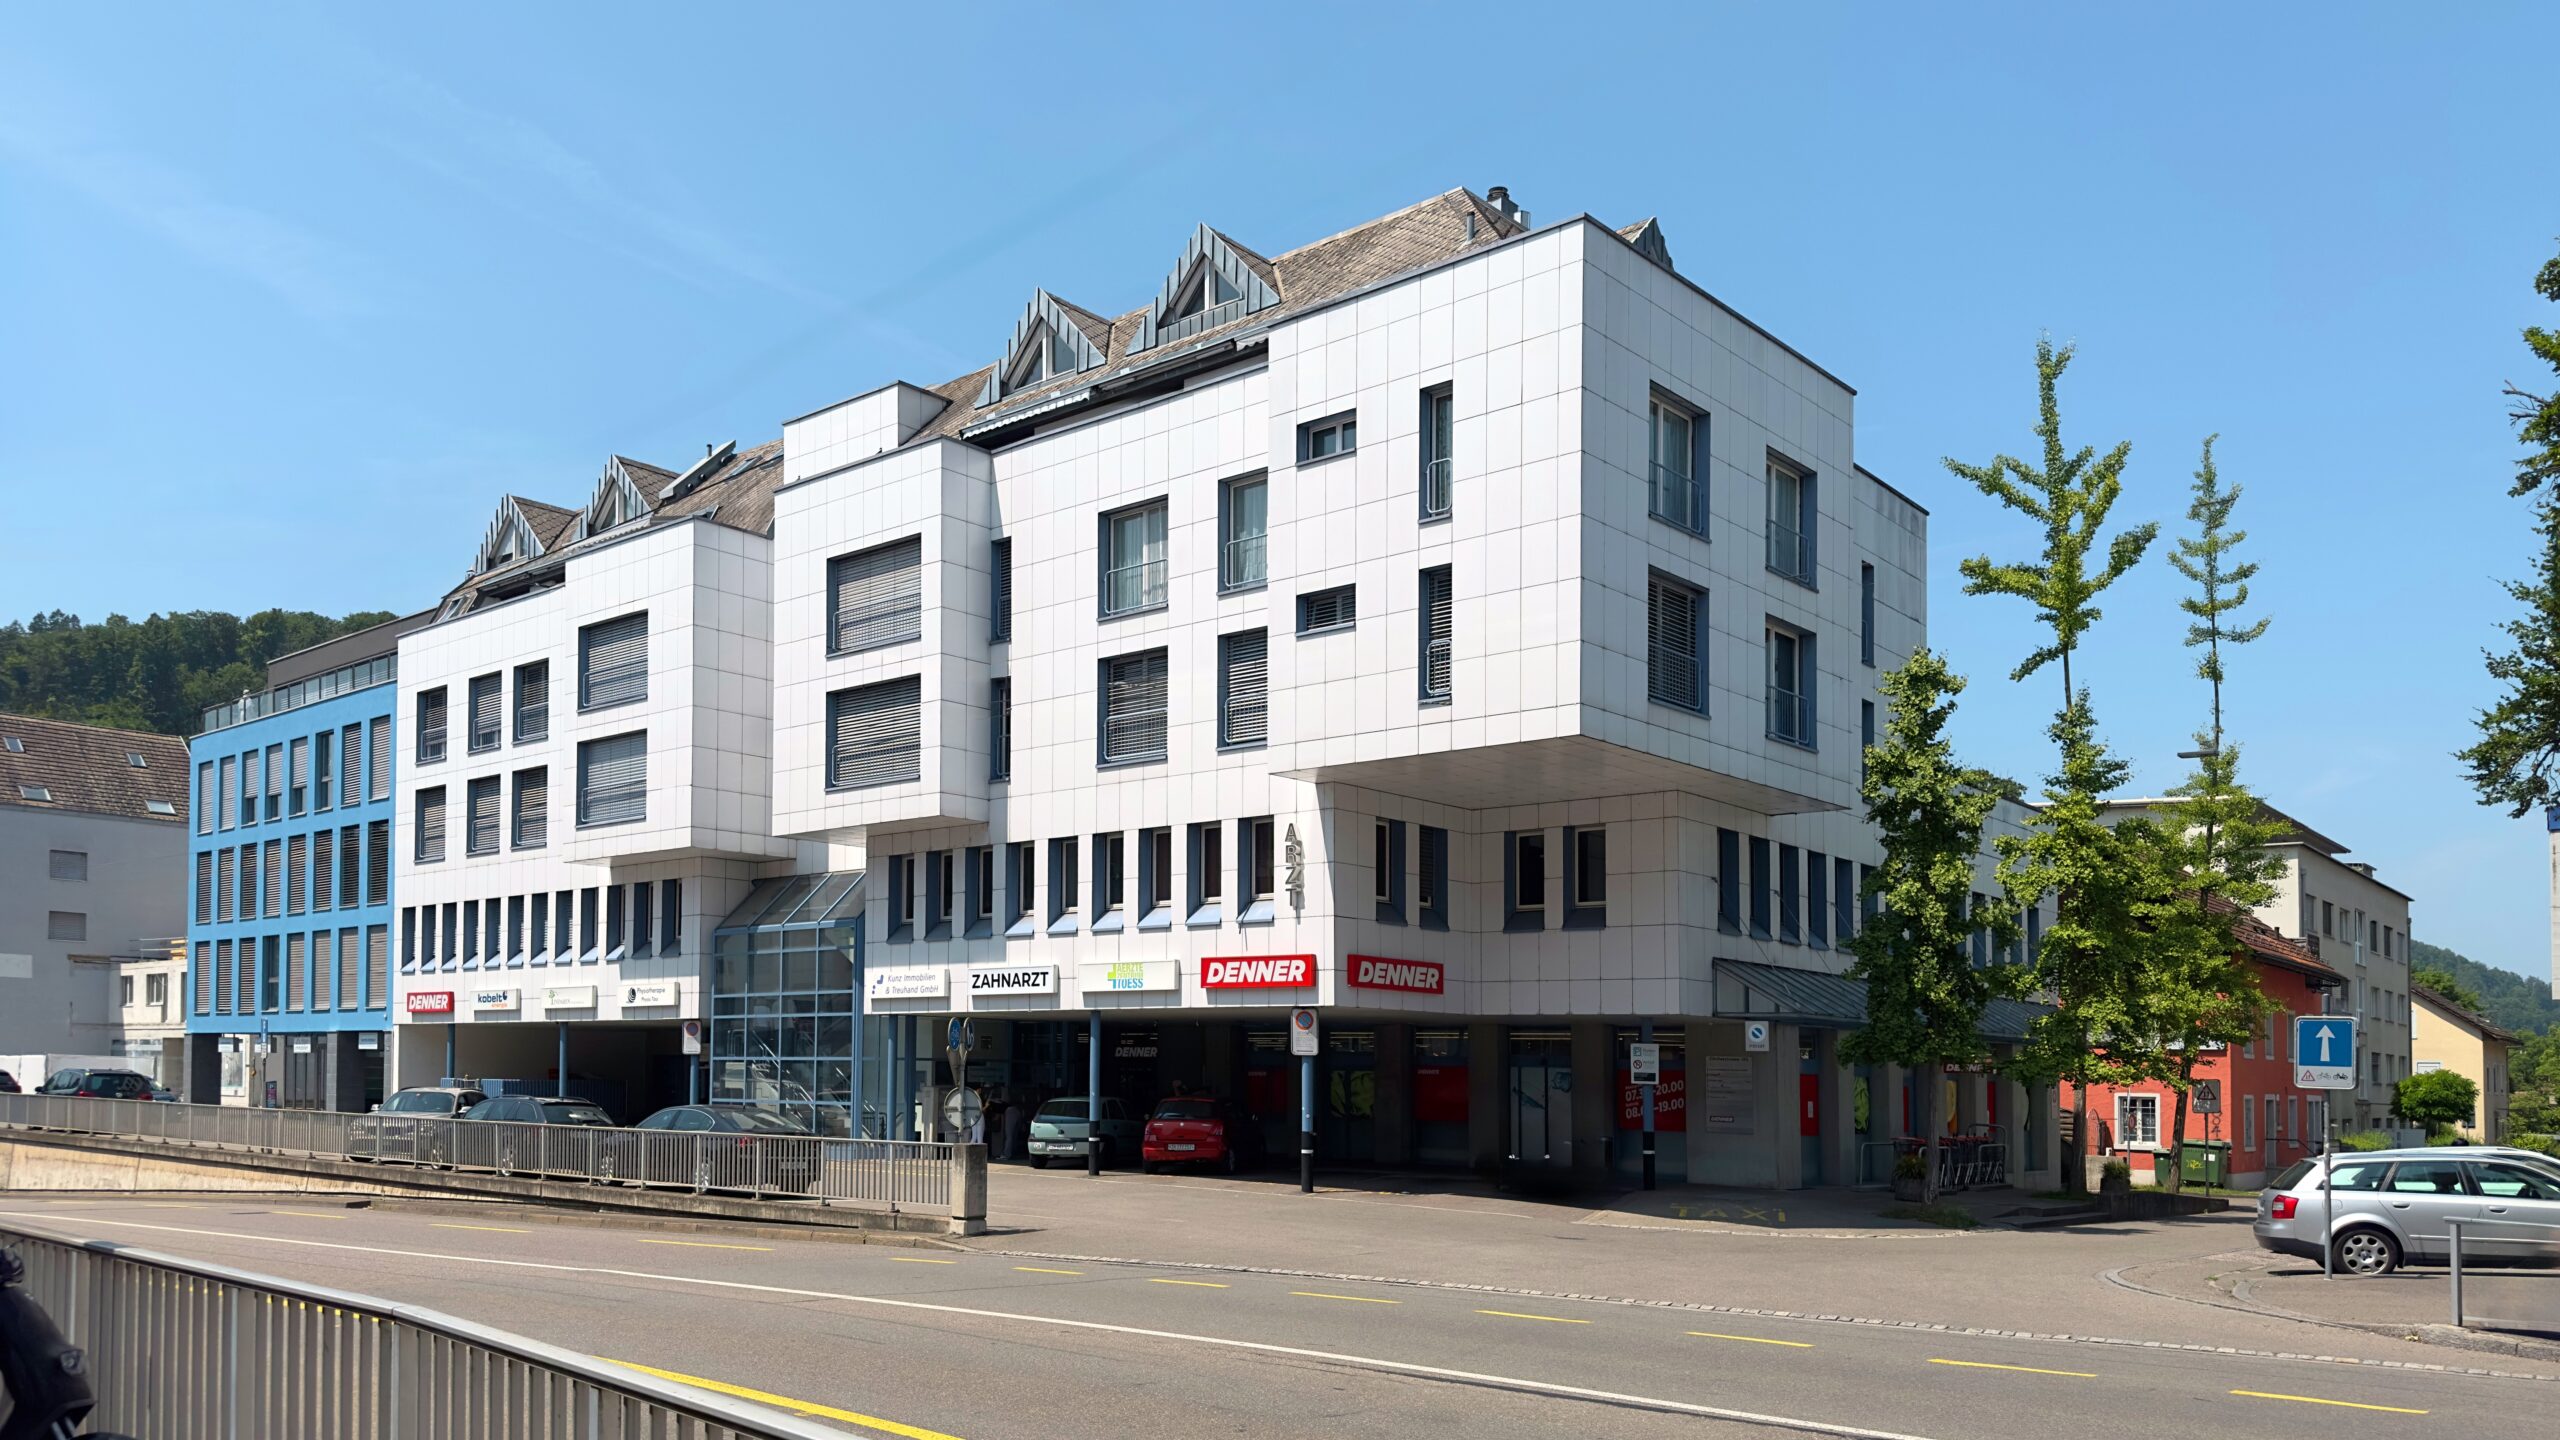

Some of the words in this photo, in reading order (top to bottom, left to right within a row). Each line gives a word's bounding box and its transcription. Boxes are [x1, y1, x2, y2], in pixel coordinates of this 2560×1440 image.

[1285, 822, 1301, 909] ARZT
[1117, 962, 1144, 972] AERZTE
[1205, 959, 1307, 984] DENNER
[1357, 961, 1440, 990] DENNER
[887, 974, 902, 983] Kunz
[904, 974, 936, 982] Immobilien
[971, 970, 1049, 989] ZAHNARZT
[885, 986, 890, 995] &
[892, 985, 919, 994] Treuhand
[920, 985, 939, 993] GmbH
[408, 994, 449, 1010] DENNER
[1114, 1046, 1158, 1058] DENNER
[1669, 1202, 1787, 1224] TAXI
